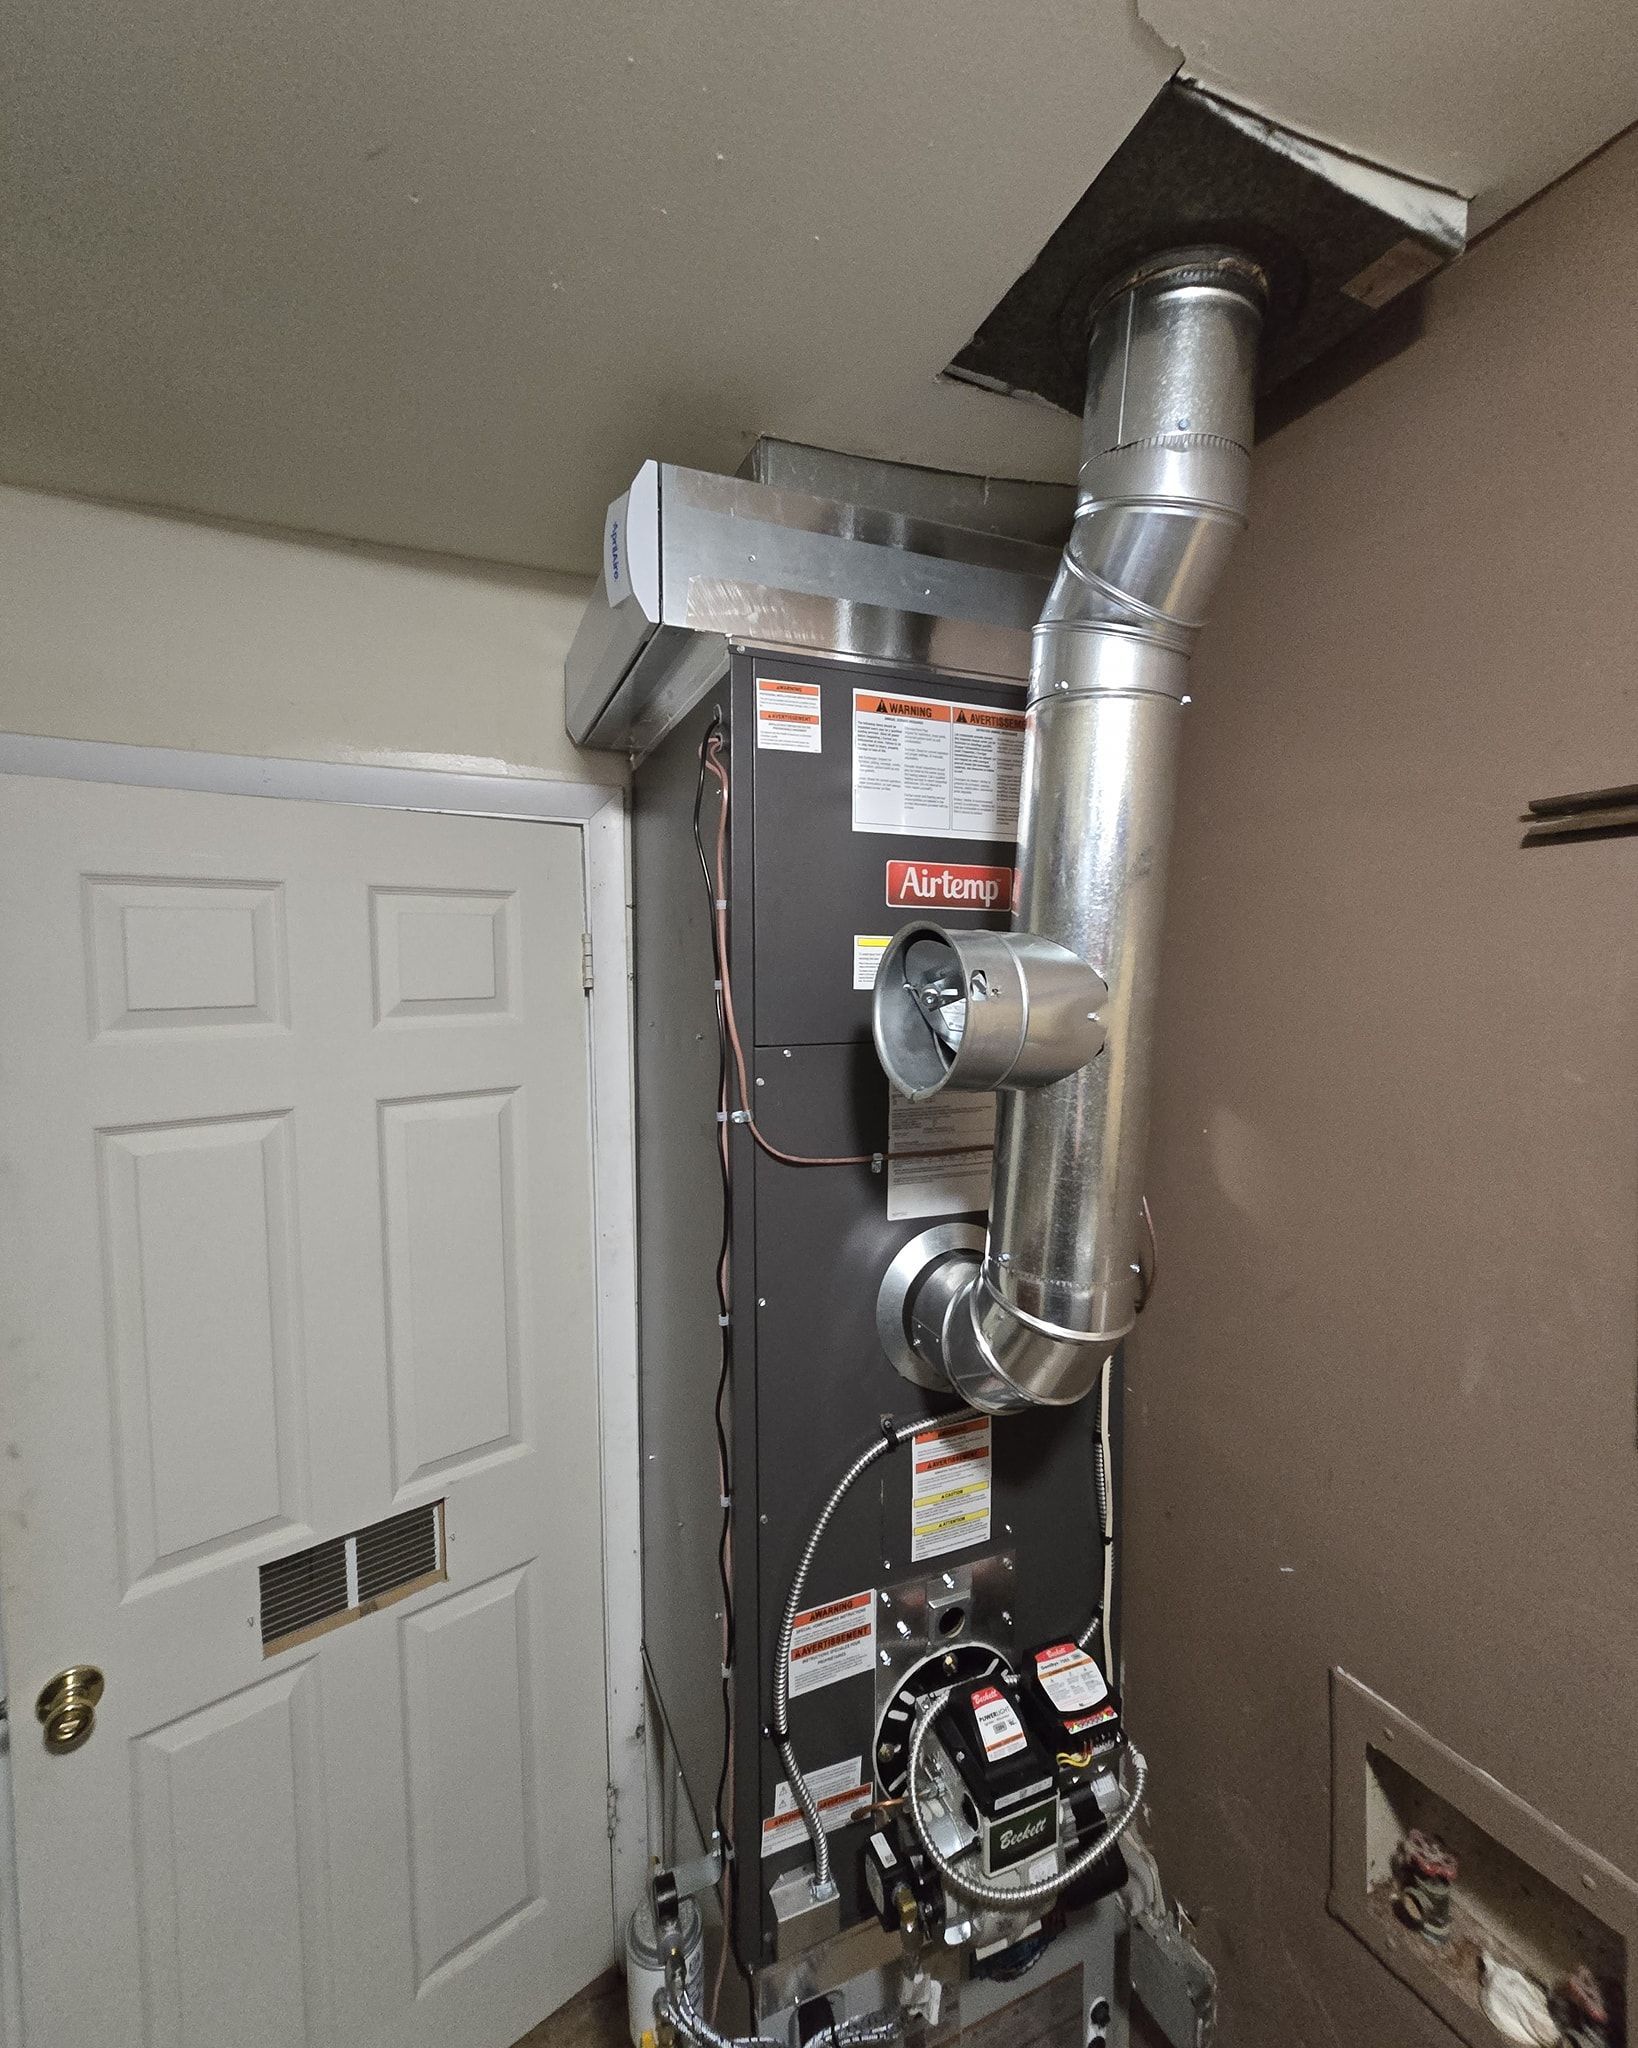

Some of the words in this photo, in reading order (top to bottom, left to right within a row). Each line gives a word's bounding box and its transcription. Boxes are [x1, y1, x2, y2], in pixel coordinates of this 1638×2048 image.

[889, 702, 932, 718] WARNING
[900, 866, 999, 908] Airtemp
[945, 1489, 964, 1498] CAUTION
[943, 1516, 966, 1527] ATTENTION
[815, 1600, 853, 1619] WARNING
[801, 1627, 868, 1655] AVERTISSEMENT
[975, 1689, 997, 1705] Beckett
[999, 1816, 1047, 1850] Beckett
